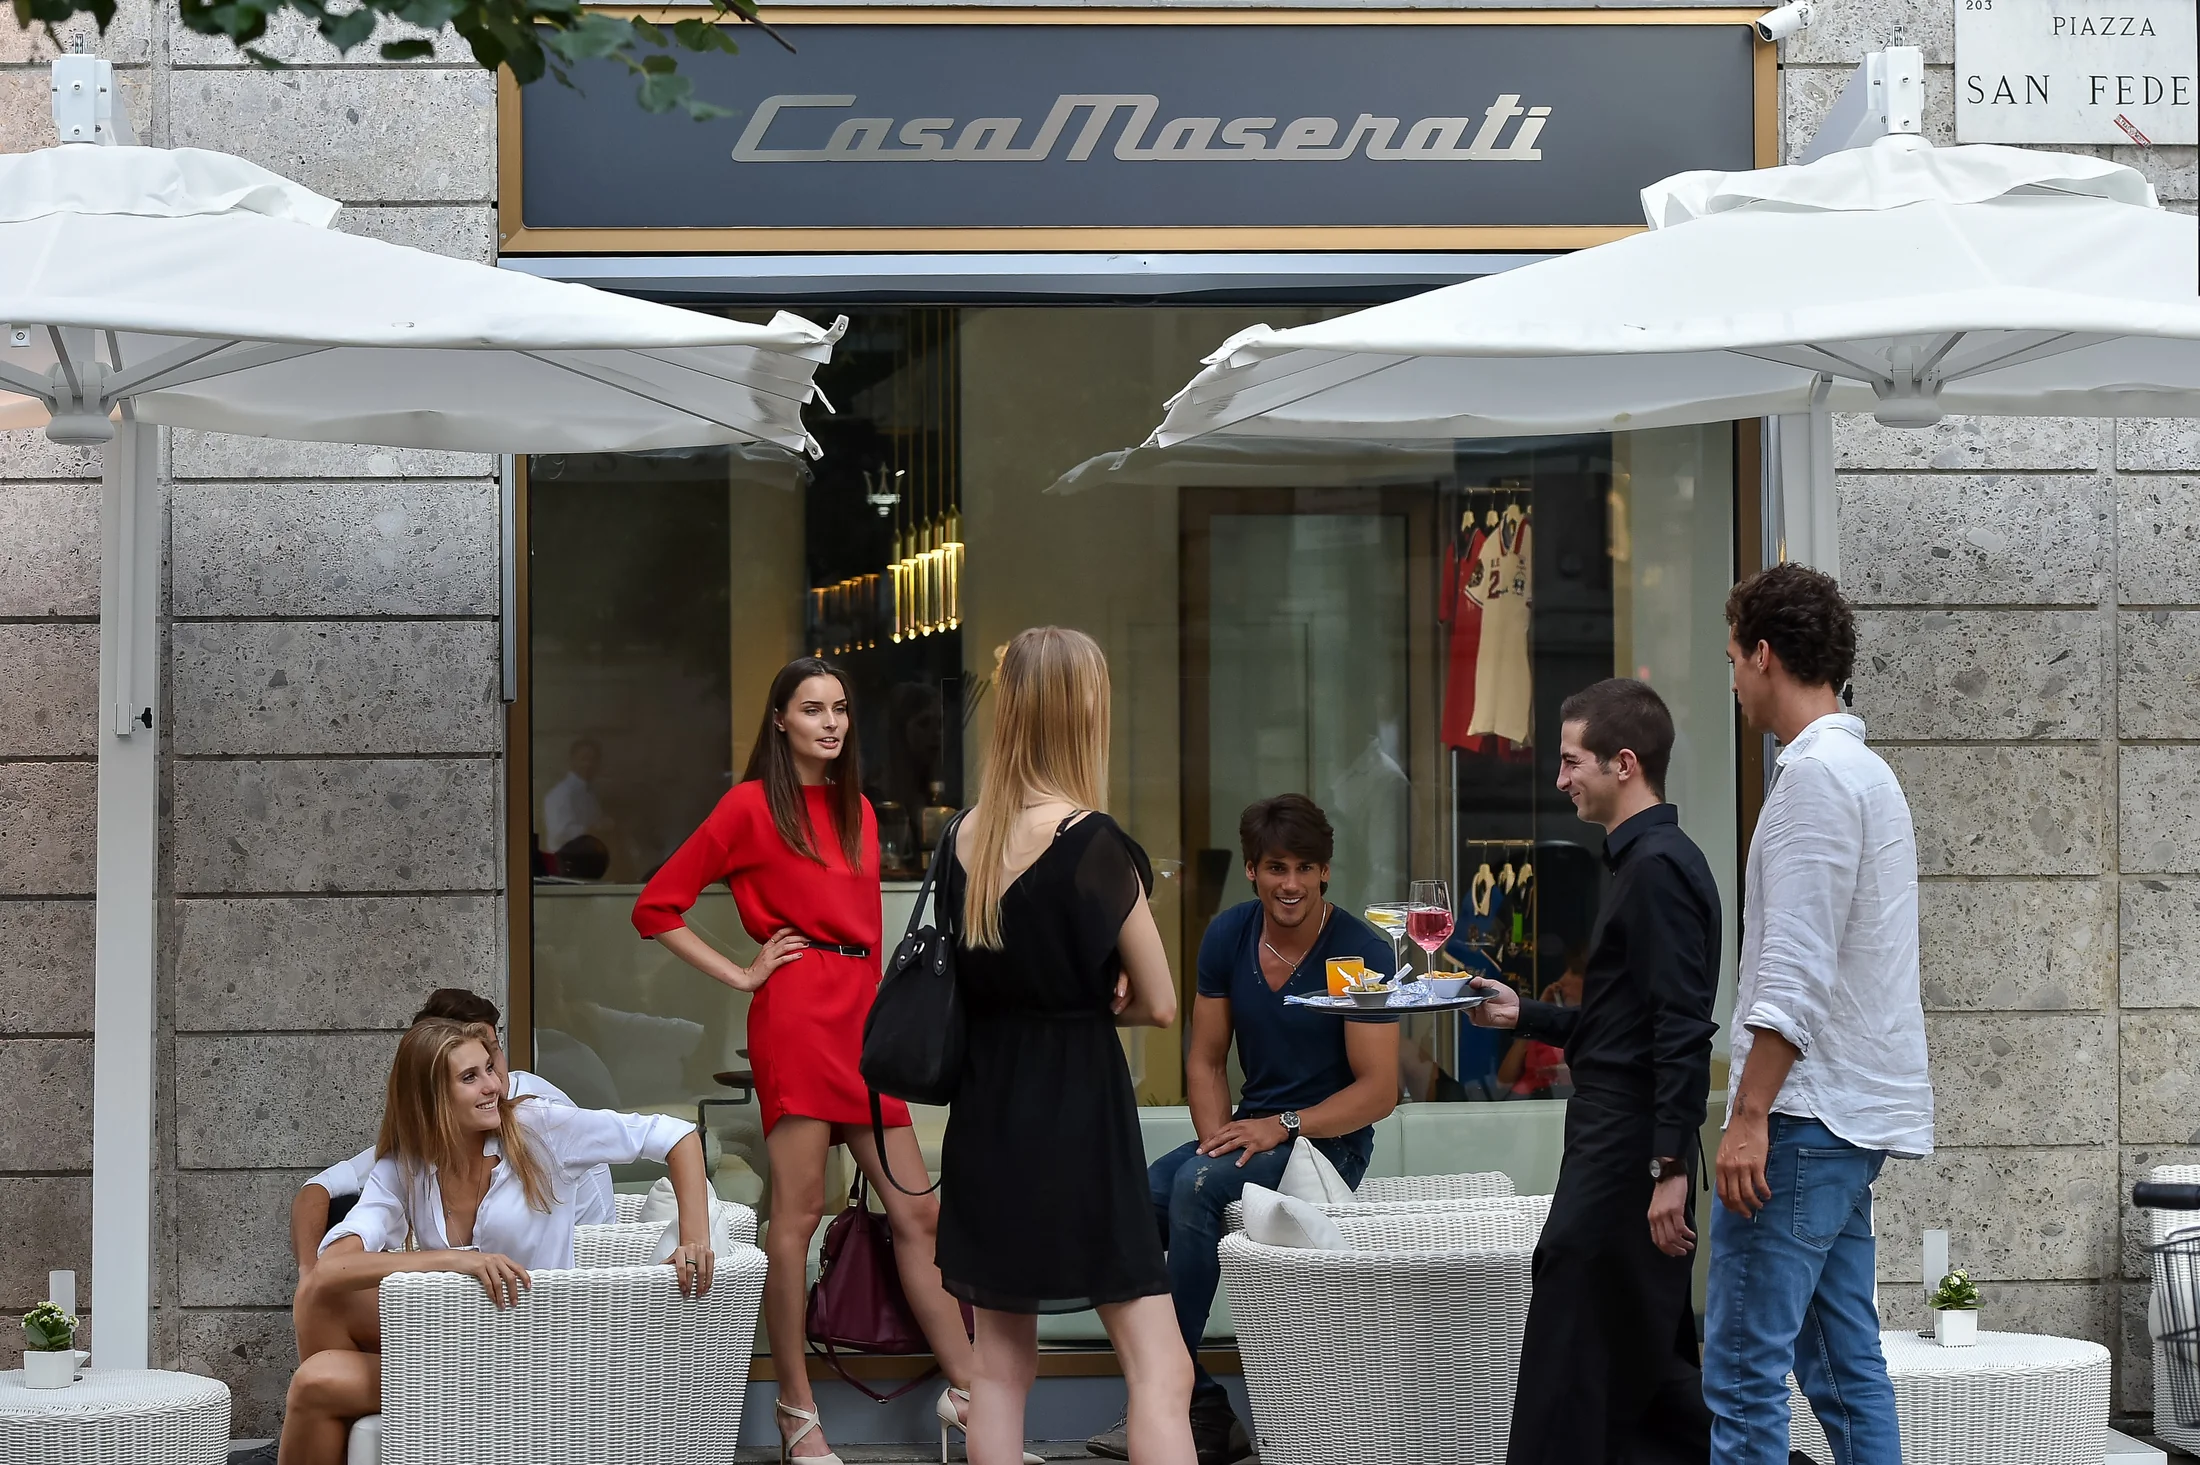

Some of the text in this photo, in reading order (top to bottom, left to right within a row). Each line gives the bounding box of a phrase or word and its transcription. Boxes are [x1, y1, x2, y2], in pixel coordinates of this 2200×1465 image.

[1965, 0, 1993, 10] 203
[2053, 17, 2156, 36] PIAZZA
[1967, 75, 2191, 105] SAN FEDE
